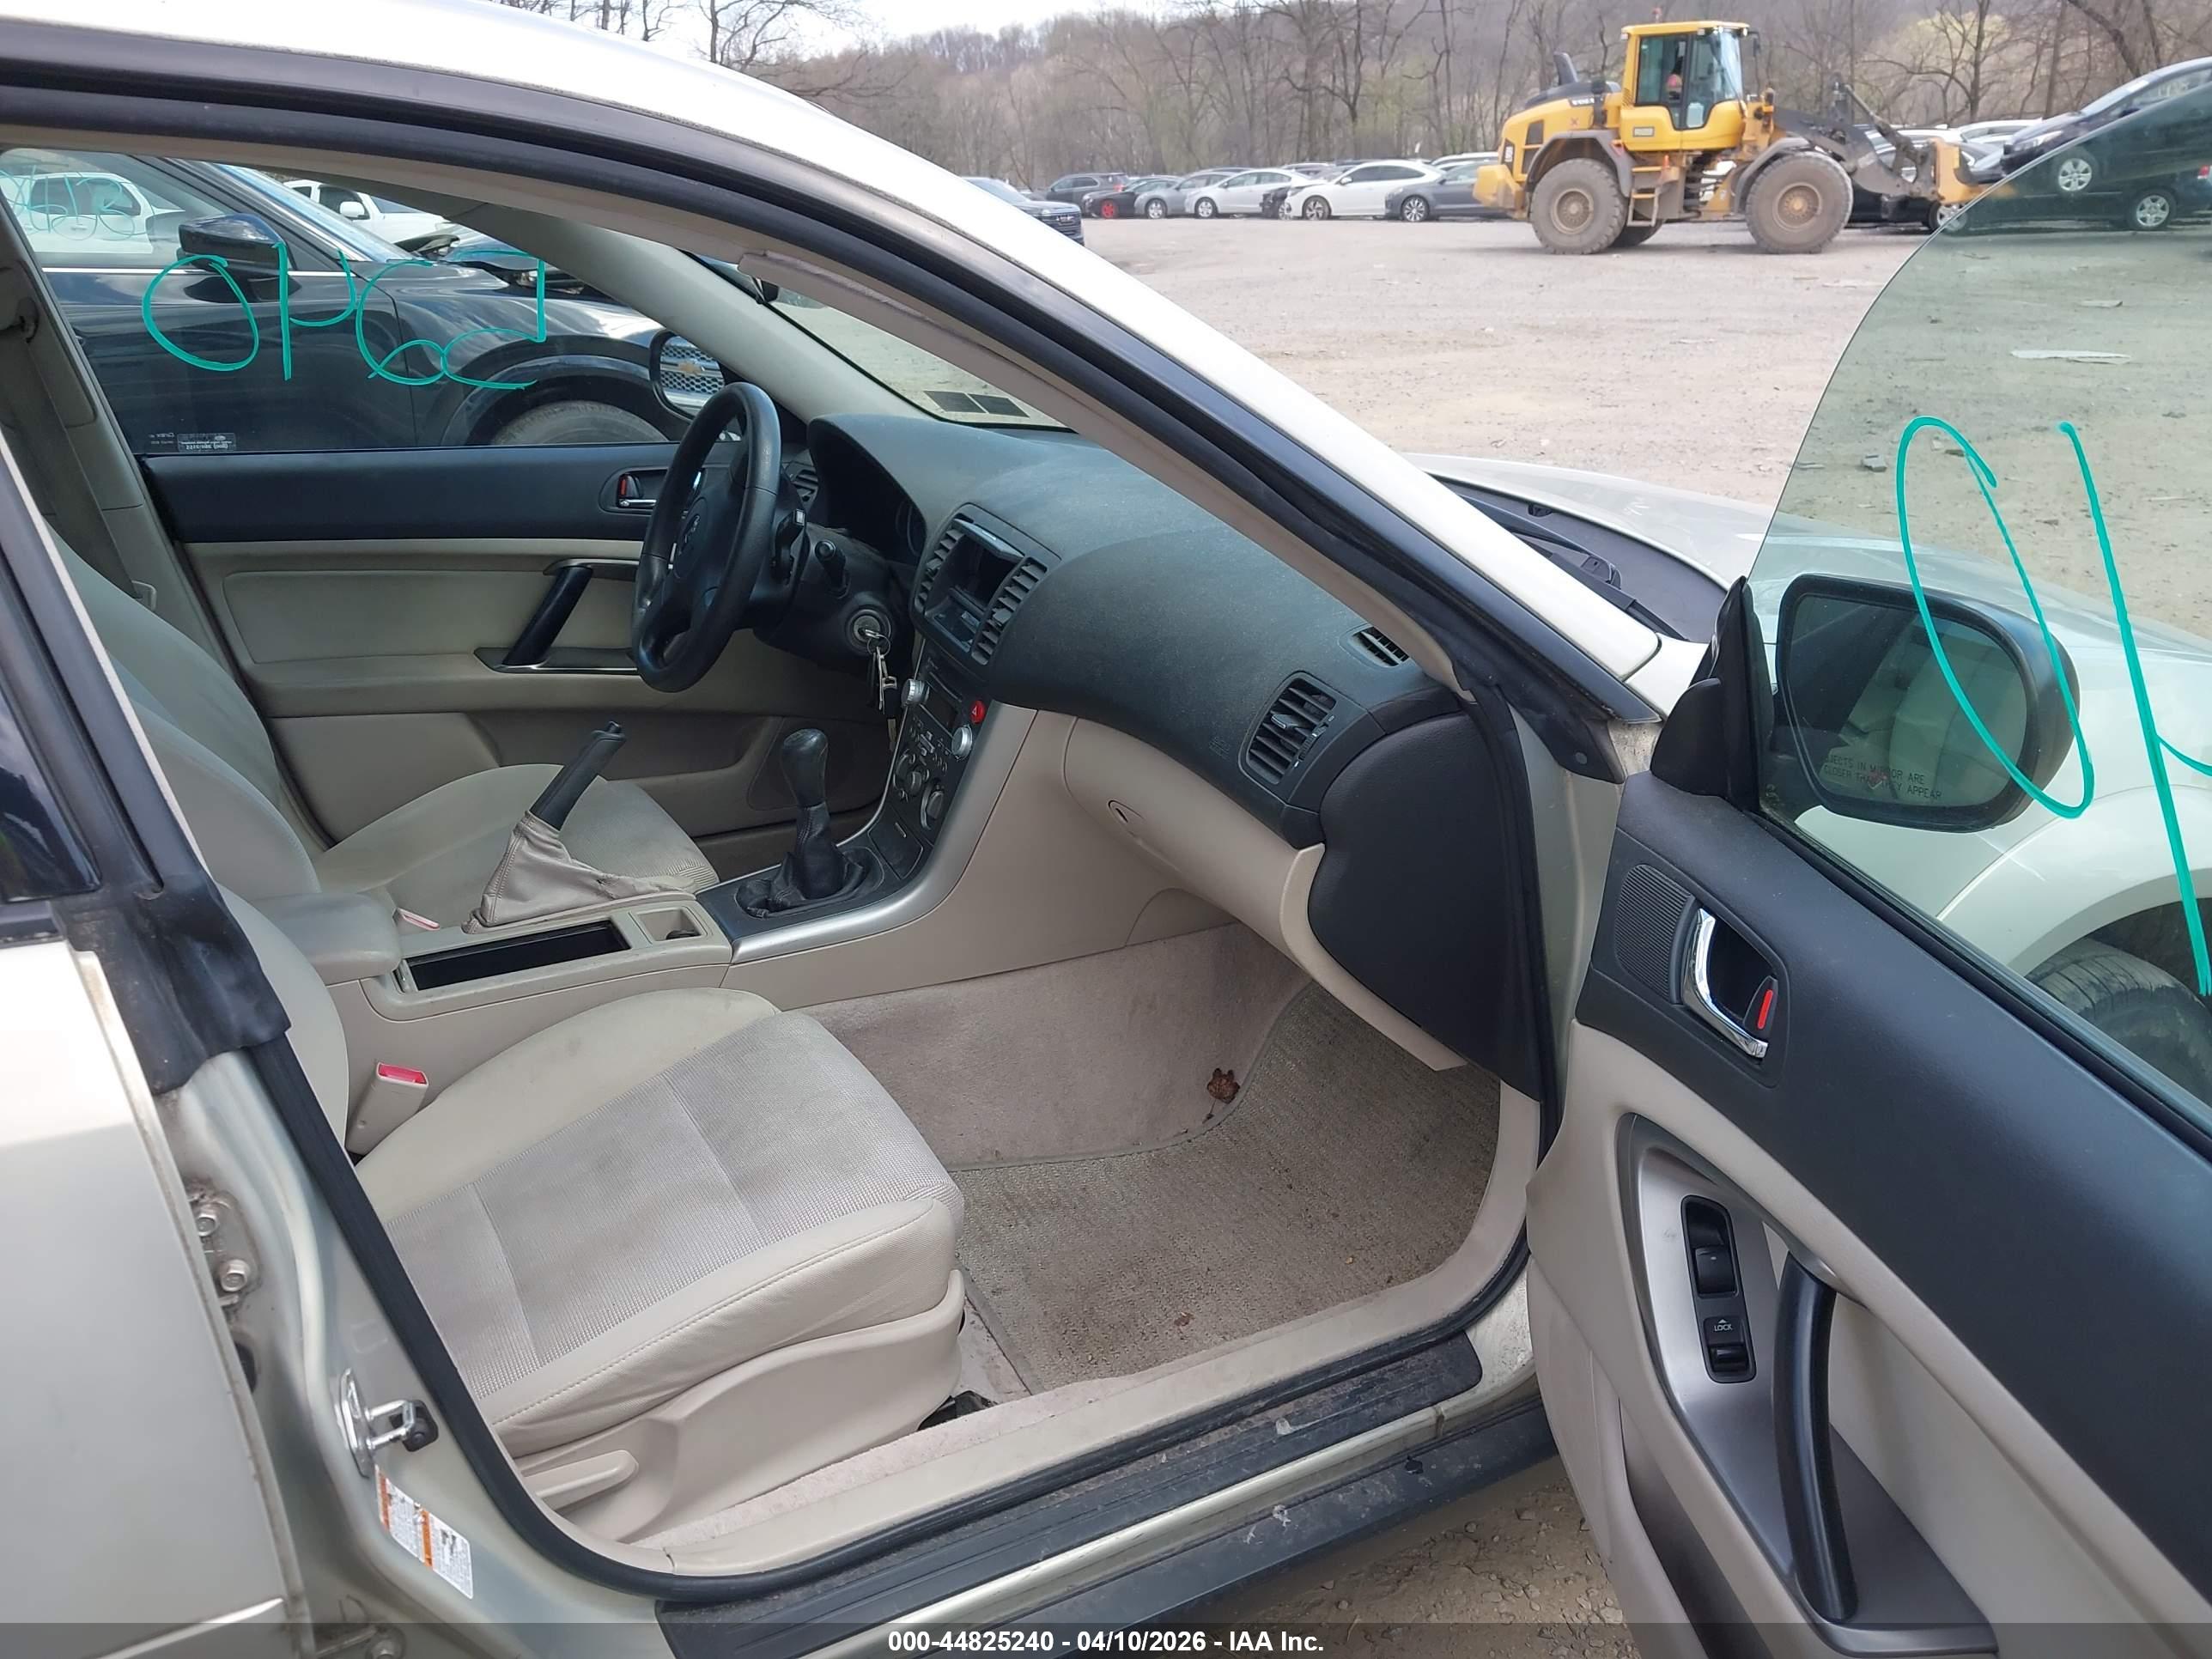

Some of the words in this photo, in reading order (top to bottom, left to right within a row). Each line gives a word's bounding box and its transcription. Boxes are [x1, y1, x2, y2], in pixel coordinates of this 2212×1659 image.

[1857, 762, 1867, 771] IN
[1908, 772, 1926, 785] ARE
[1907, 786, 1942, 800] APPEAR
[1713, 1323, 1734, 1332] LOCK
